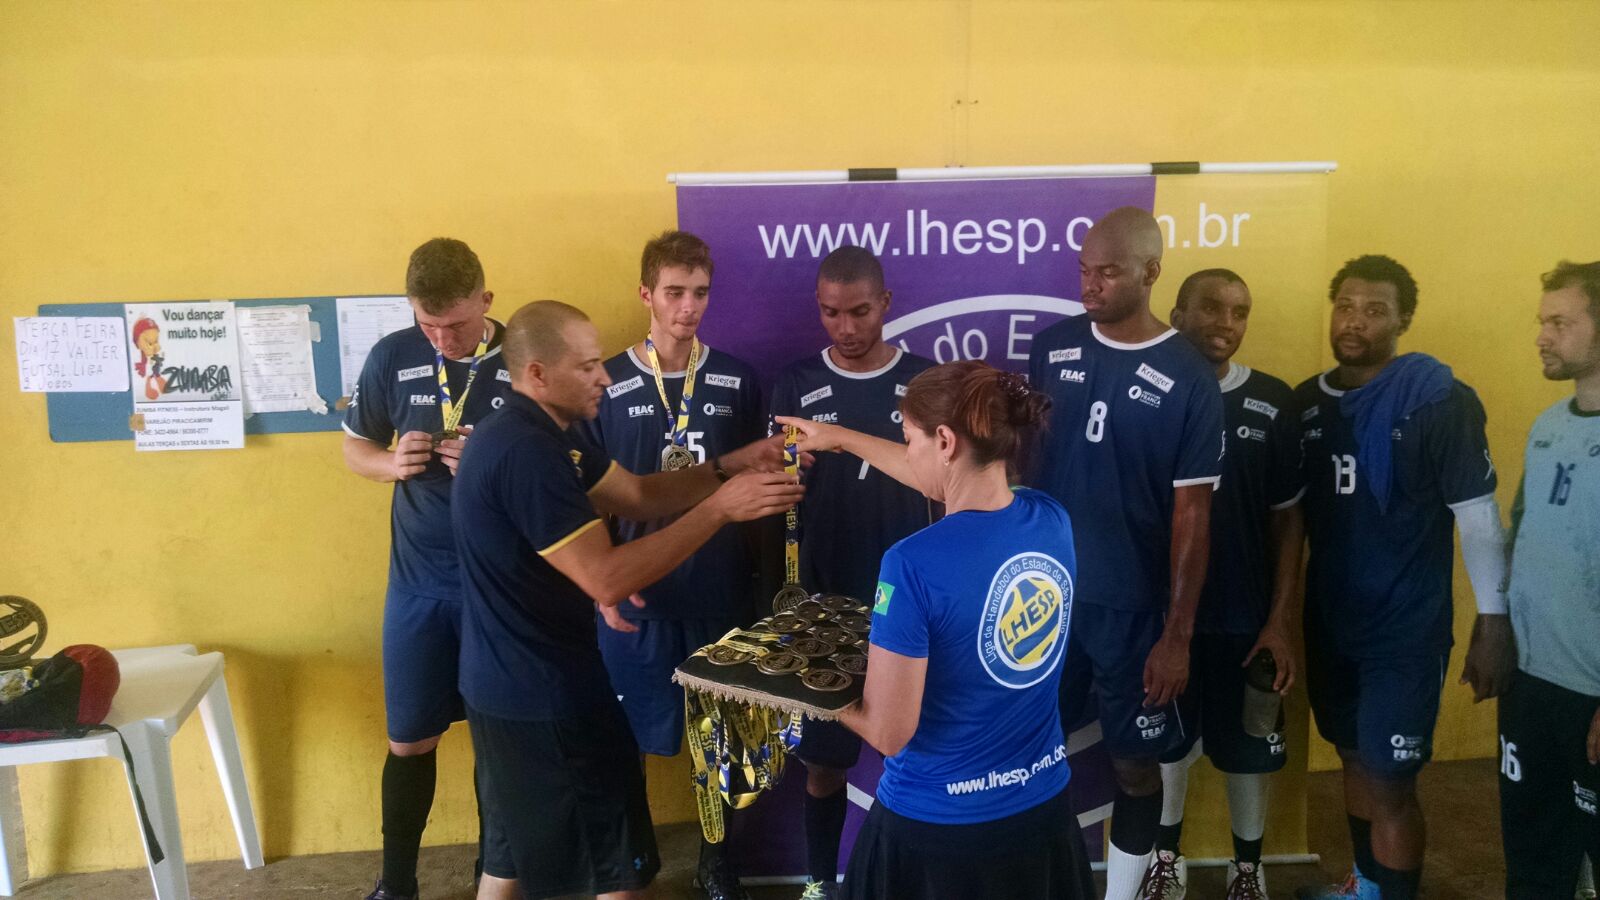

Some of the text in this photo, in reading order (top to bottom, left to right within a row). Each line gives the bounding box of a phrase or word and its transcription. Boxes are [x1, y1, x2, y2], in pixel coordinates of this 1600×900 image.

[757, 202, 1250, 265] www.lhesp.c.br
[162, 309, 184, 320] Vou
[186, 308, 224, 324] dançar
[75, 317, 117, 339] FEIRA
[168, 327, 198, 339] muito
[200, 326, 226, 342] hoje!
[933, 322, 988, 364] do
[1052, 350, 1077, 358] Krieger
[161, 364, 232, 394] ZUMBA
[400, 366, 431, 378] Krieger
[1060, 368, 1086, 380] FEAC
[1140, 366, 1171, 388] Krieger
[608, 378, 640, 395] Krieger
[708, 376, 738, 388] Krieger
[410, 394, 436, 404] FEAC
[802, 387, 830, 404] Krieger
[628, 404, 655, 416] FEAC
[812, 412, 838, 422] FEAC
[1085, 400, 1108, 443] 8
[1332, 454, 1357, 494] 13
[1548, 462, 1576, 506] 16
[1010, 563, 1020, 576] do
[1022, 558, 1052, 576] Estado
[1052, 568, 1062, 582] de
[986, 570, 1011, 622] Handebol
[1002, 589, 1055, 646] LHESP
[984, 626, 994, 638] de
[984, 640, 998, 664] Liga
[1500, 734, 1522, 782] 16
[946, 744, 1066, 795] www.lhesp.com.br
